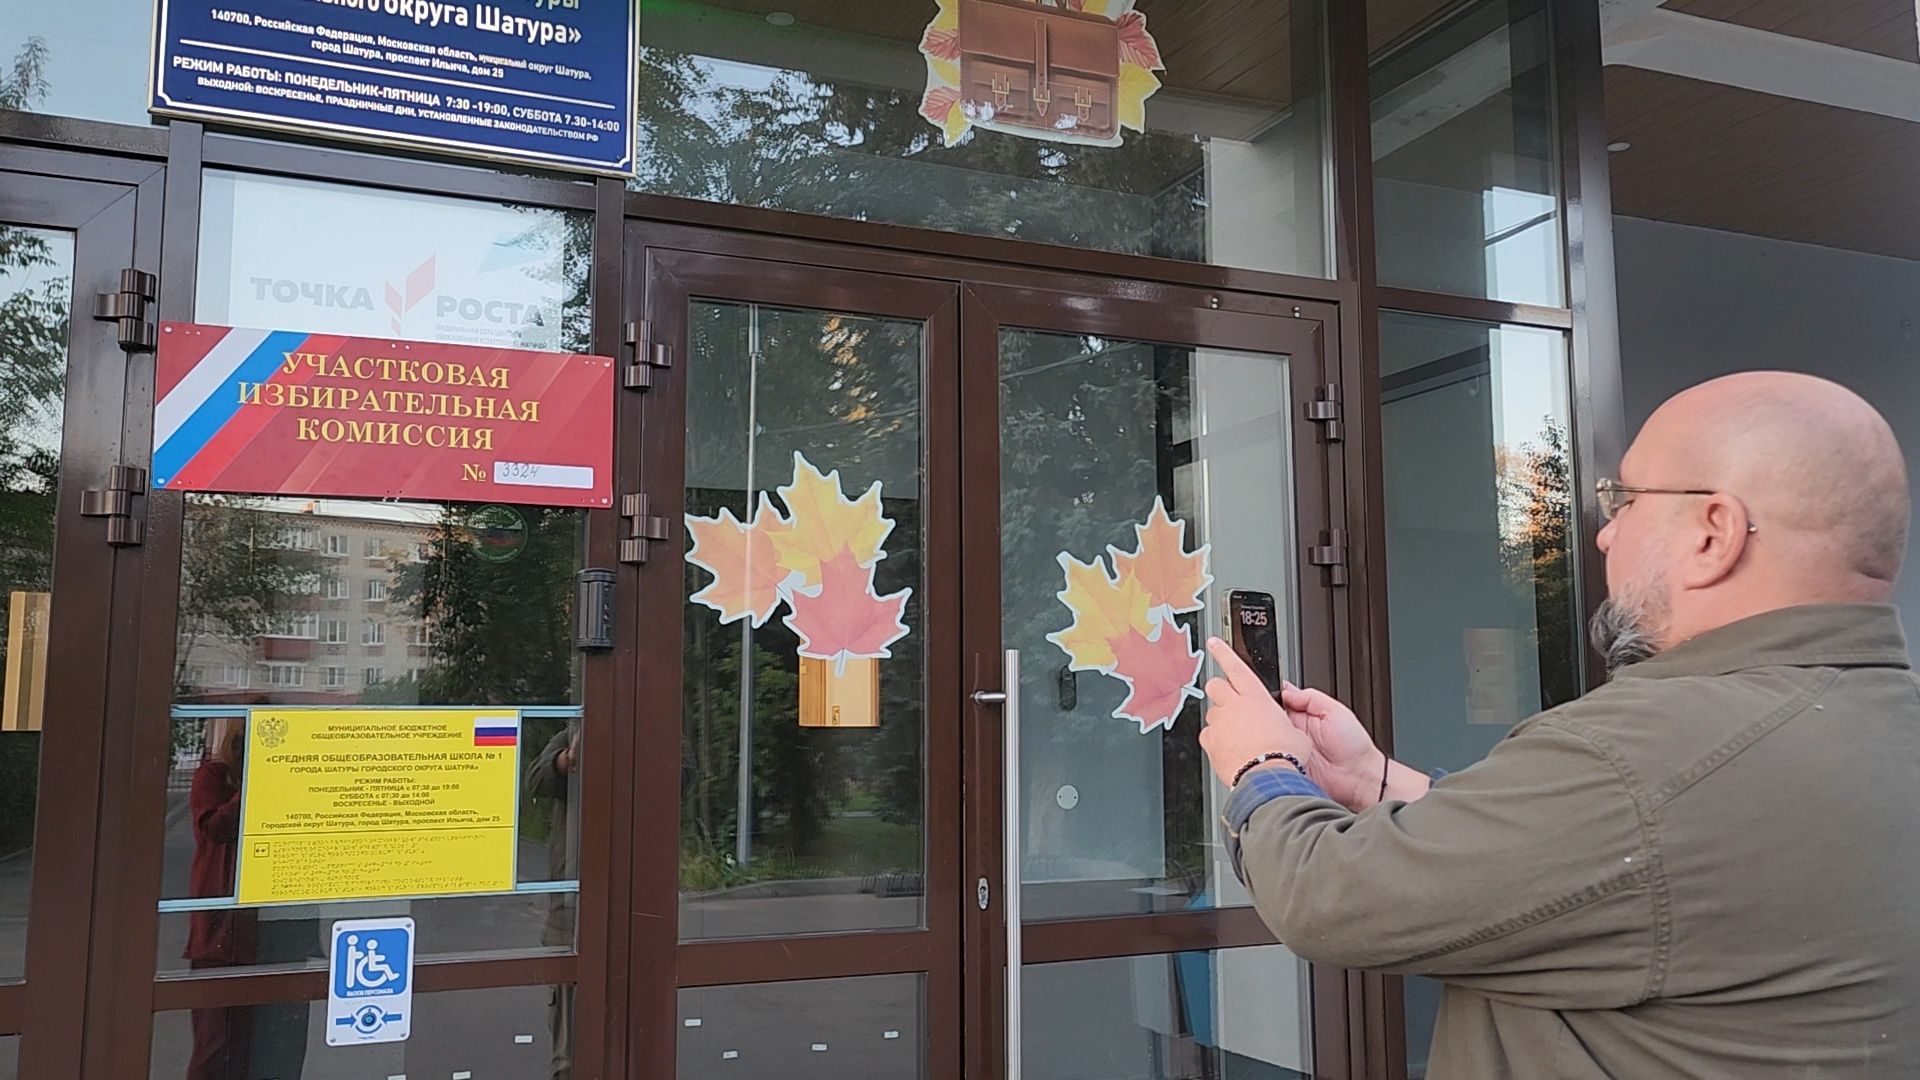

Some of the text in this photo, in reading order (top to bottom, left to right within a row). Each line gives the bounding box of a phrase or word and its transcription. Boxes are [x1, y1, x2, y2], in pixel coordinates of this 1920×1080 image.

[476, 4, 582, 45] Шатура»
[211, 9, 252, 25] 140700,
[254, 15, 314, 34] Российская
[316, 25, 375, 45] Федерация,
[377, 35, 435, 54] Московская
[437, 46, 477, 62] область,
[528, 62, 553, 74] округ
[555, 64, 592, 80] Шатура,
[311, 40, 503, 78] город Шатура, проспект Ильича, дом 25
[173, 55, 223, 73] РЕЖИМ
[226, 63, 282, 82] РАБОТЫ:
[284, 71, 440, 106] ПОНЕДЕЛЬНИК-ПЯТНИЦА
[445, 96, 469, 110] 7:30
[513, 106, 562, 124] СУББОТА
[564, 114, 619, 132] 7.30-14:00
[197, 76, 599, 142] ВЫХОДНОЙ: ВОСКРЕСЕНЬЕ, ПРАЗДНИЧНЫЕ ДНИ, УСТАНОВЛЕННЫЕ ЗАКОНОДАТЕЛЬСТВОМ РФ
[250, 276, 544, 327] ТОЧКА РОСТА
[281, 351, 510, 390] УЧАСТКОВАЯ
[237, 381, 540, 423] ИЗБИРАТЕЛЬНАЯ
[296, 417, 494, 451] КОМИССИЯ
[462, 463, 487, 482] №
[1240, 610, 1268, 626] 18:25
[311, 732, 412, 740] ОБЩЕОБРАЗОВАТЕЛЬНОЕ
[399, 724, 448, 732] БЮДЖЕТНОЕ
[266, 754, 320, 763] «СРЕДНЯЯ
[321, 753, 448, 763] ОБЩЕОБРАЗОВАТЕЛЬНАЯ
[449, 752, 483, 761] ШКОЛА
[289, 766, 322, 774] ГОРОДА
[361, 765, 413, 773] ГОРОДСКОГО
[444, 764, 479, 772] ШАТУРА»
[286, 813, 314, 821] 140700,
[315, 812, 359, 820] Российская
[448, 808, 480, 816] область,
[333, 800, 387, 808] ВОСКРЕСЕНЬЕ
[393, 798, 436, 806] ВЫХОДНОЙ
[261, 821, 302, 830] Городской
[303, 821, 324, 829] округ
[326, 819, 356, 828] Шатура,
[358, 819, 380, 828] город
[381, 817, 410, 826] Шатура,
[412, 817, 445, 825] проспект
[446, 815, 475, 824] Ильича,
[475, 816, 491, 824] дом
